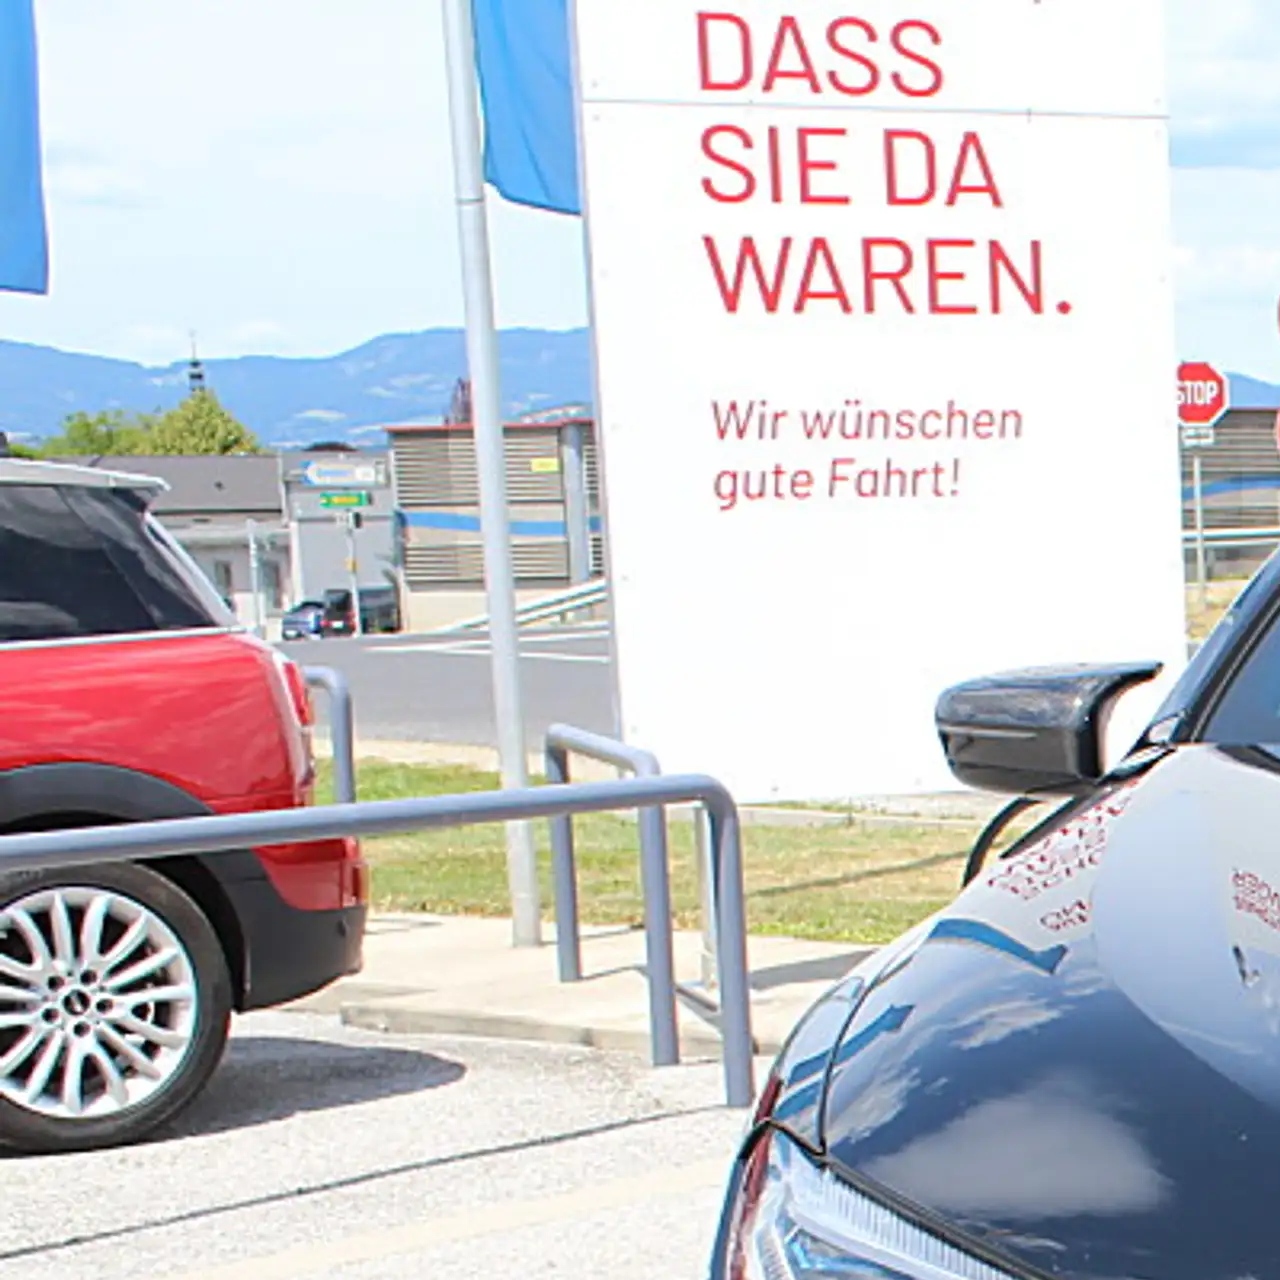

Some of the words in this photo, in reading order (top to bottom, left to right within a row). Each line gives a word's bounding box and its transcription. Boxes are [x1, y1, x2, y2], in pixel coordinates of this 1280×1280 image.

[695, 11, 945, 98] DASS
[699, 122, 853, 207] SIE
[881, 128, 1004, 209] DA
[701, 233, 1074, 316] WAREN.
[712, 399, 789, 441] Wir
[801, 399, 1024, 441] wünschen
[1176, 380, 1217, 405] STOP
[714, 463, 815, 512] gute
[827, 457, 960, 499] Fahrt!
